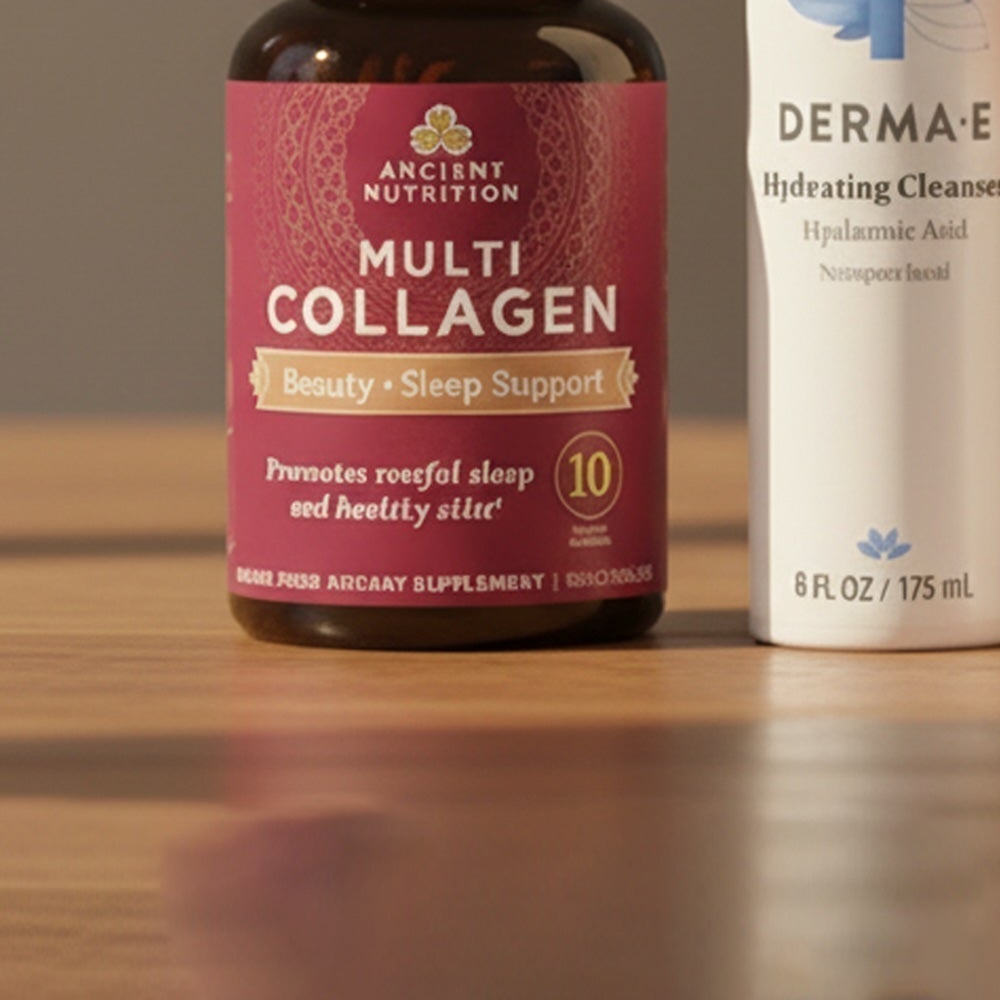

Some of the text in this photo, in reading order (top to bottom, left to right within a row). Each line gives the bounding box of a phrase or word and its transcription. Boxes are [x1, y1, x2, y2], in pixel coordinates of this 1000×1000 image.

[364, 183, 519, 204] NUTRITION
[359, 240, 520, 277] MULTI
[267, 284, 617, 337] COLLAGEN
[401, 368, 482, 405] Sleep
[492, 369, 605, 403] Support
[568, 450, 612, 498] 10
[841, 574, 874, 602] OZ
[900, 575, 936, 601] 175
